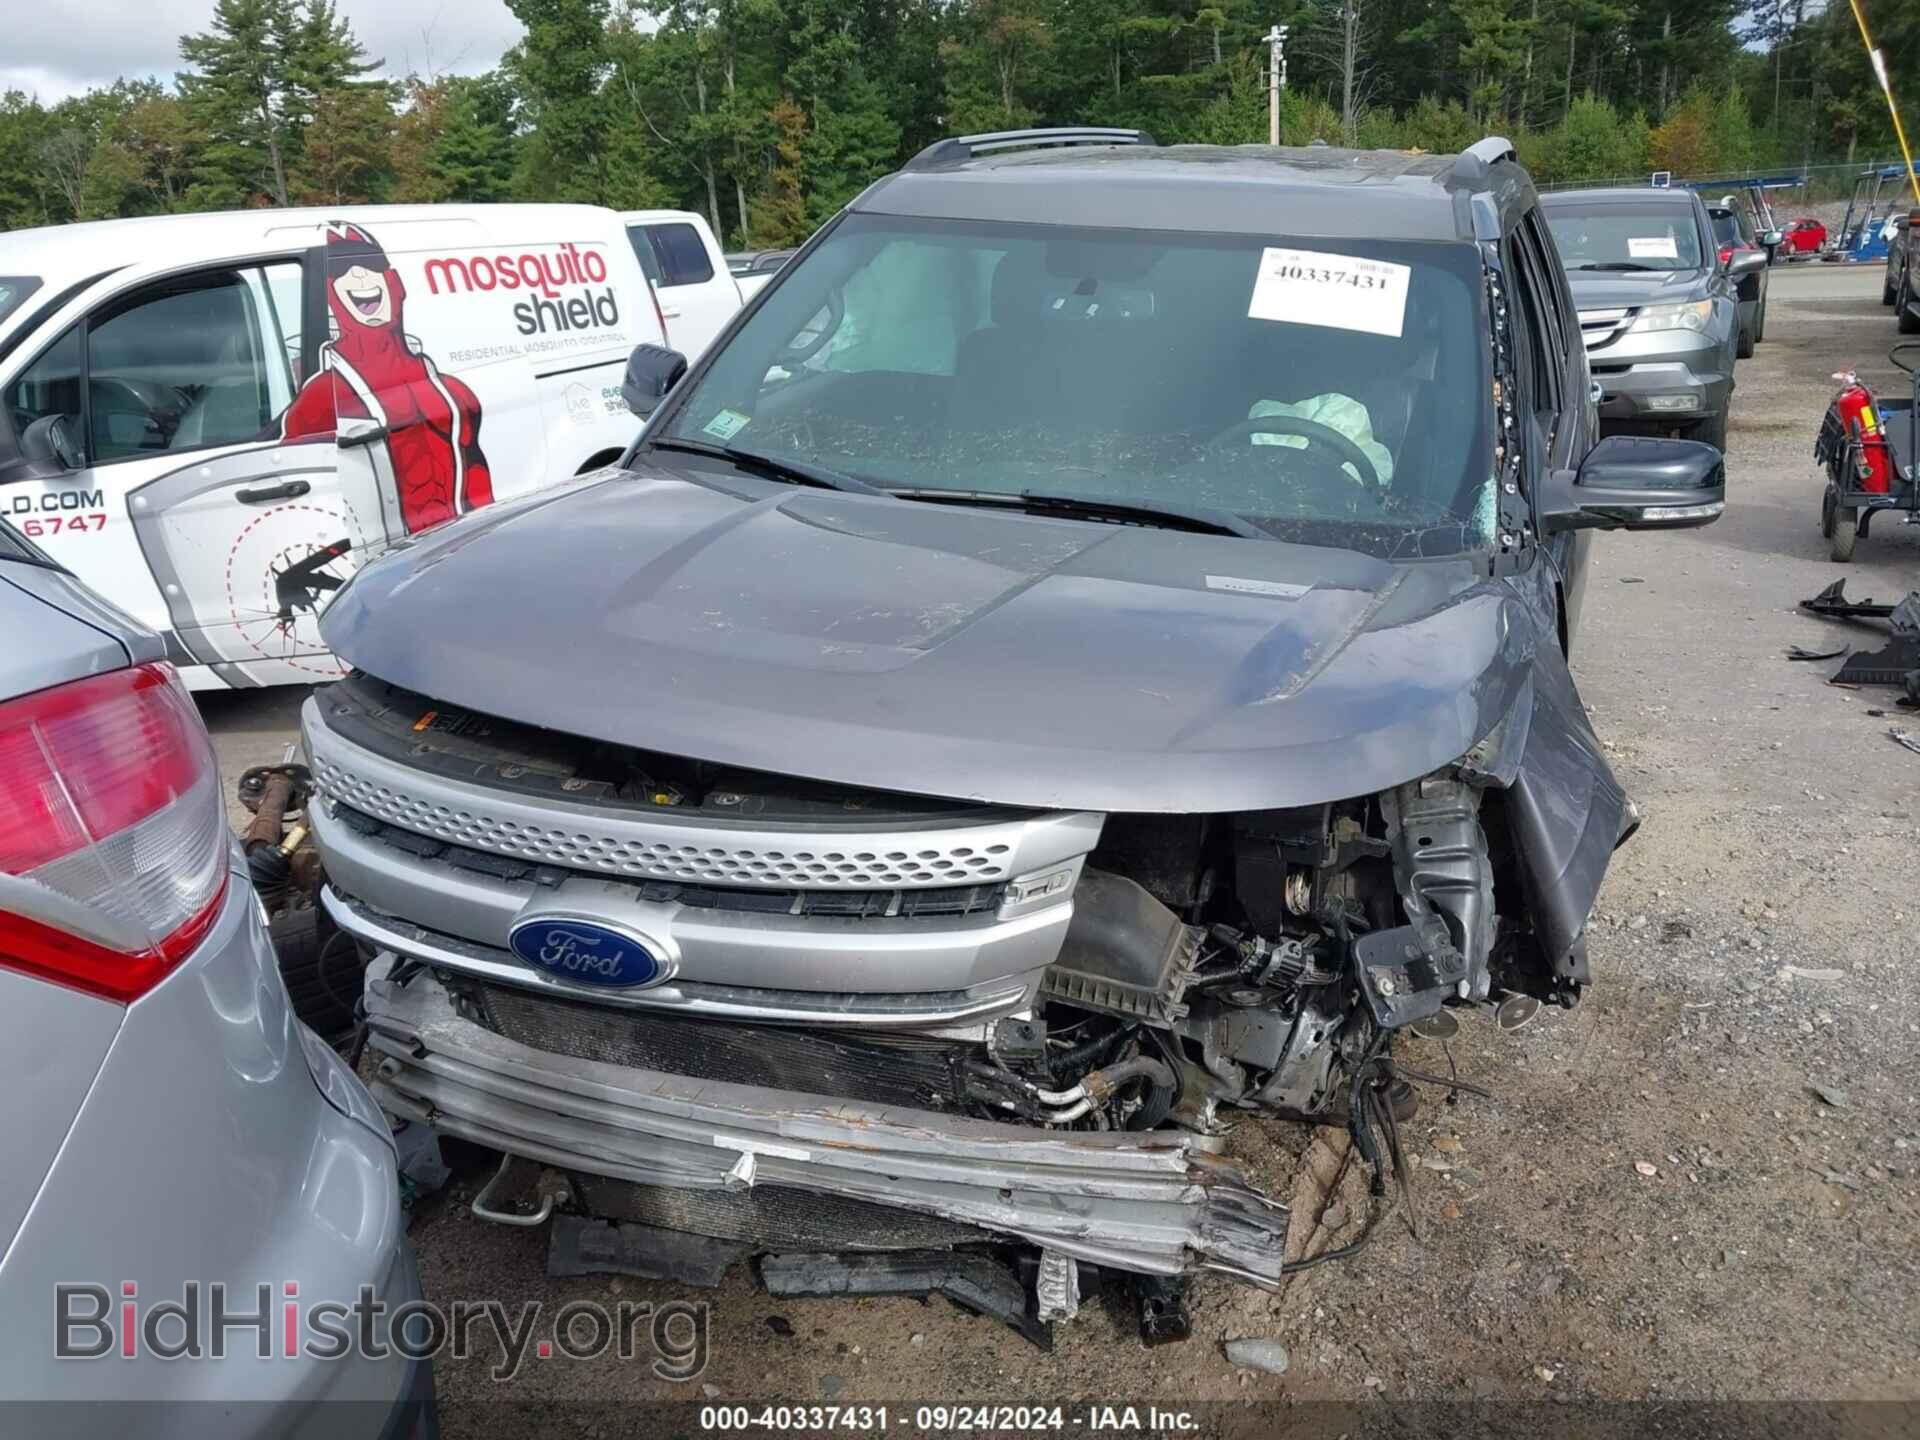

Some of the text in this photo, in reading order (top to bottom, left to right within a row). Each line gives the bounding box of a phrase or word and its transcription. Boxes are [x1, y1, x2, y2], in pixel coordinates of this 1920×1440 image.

[424, 242, 607, 298] mosquito
[1273, 265, 1387, 290] 40337431
[513, 287, 619, 335] shield
[450, 342, 522, 362] RESIDENTIAL
[24, 513, 107, 537] 6747
[539, 929, 624, 977] Ford
